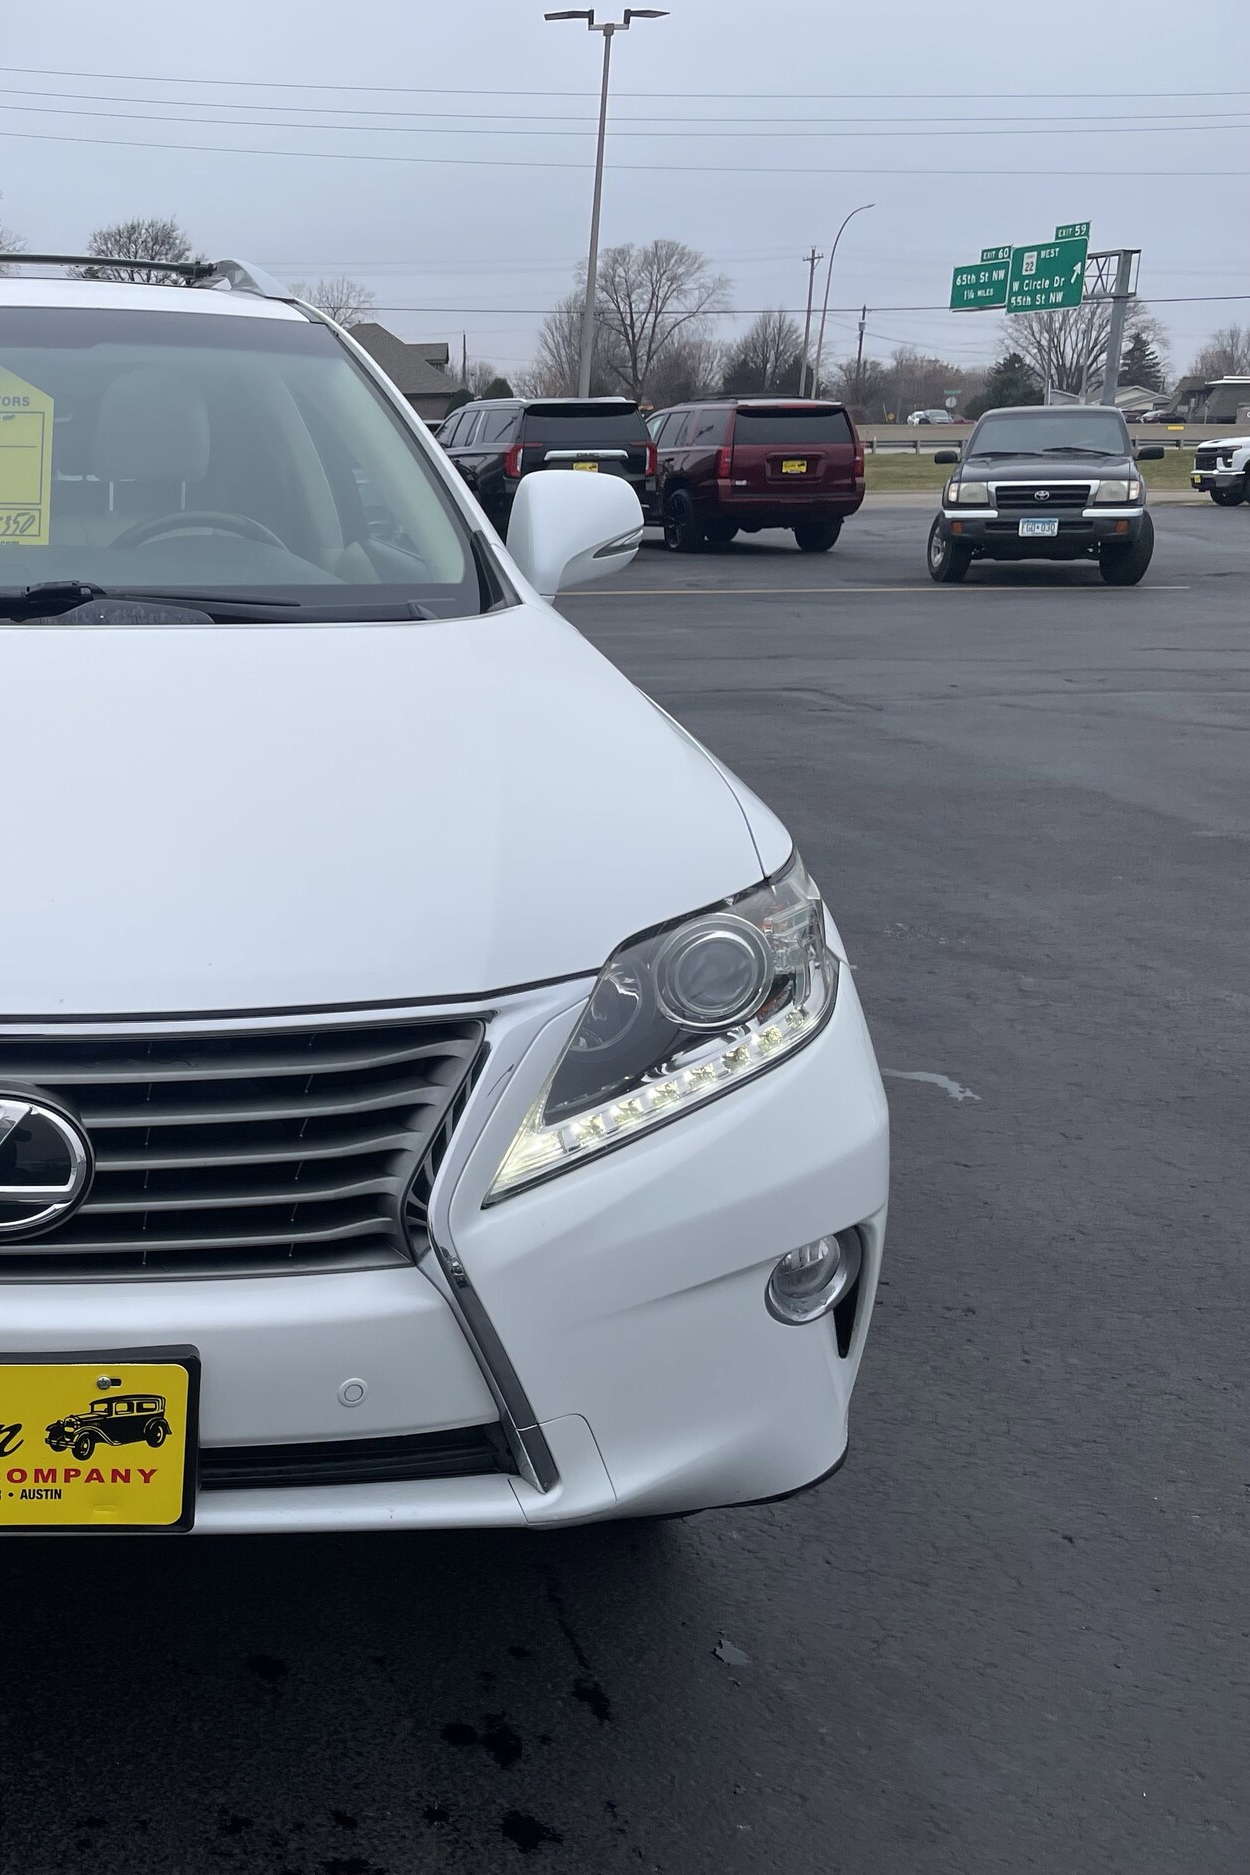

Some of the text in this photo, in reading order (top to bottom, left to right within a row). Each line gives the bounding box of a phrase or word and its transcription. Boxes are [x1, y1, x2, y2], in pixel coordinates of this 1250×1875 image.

[1058, 224, 1087, 238] EXIT 59
[983, 248, 1009, 260] EXIT 60
[1040, 248, 1059, 259] WEST
[1024, 261, 1034, 272] 22
[956, 269, 1006, 286] 65th St NW
[1012, 275, 1065, 292] W Circle Dr
[977, 288, 994, 297] MILES
[1010, 291, 1064, 307] 55th St NW
[19, 1488, 62, 1501] AUSTIN
